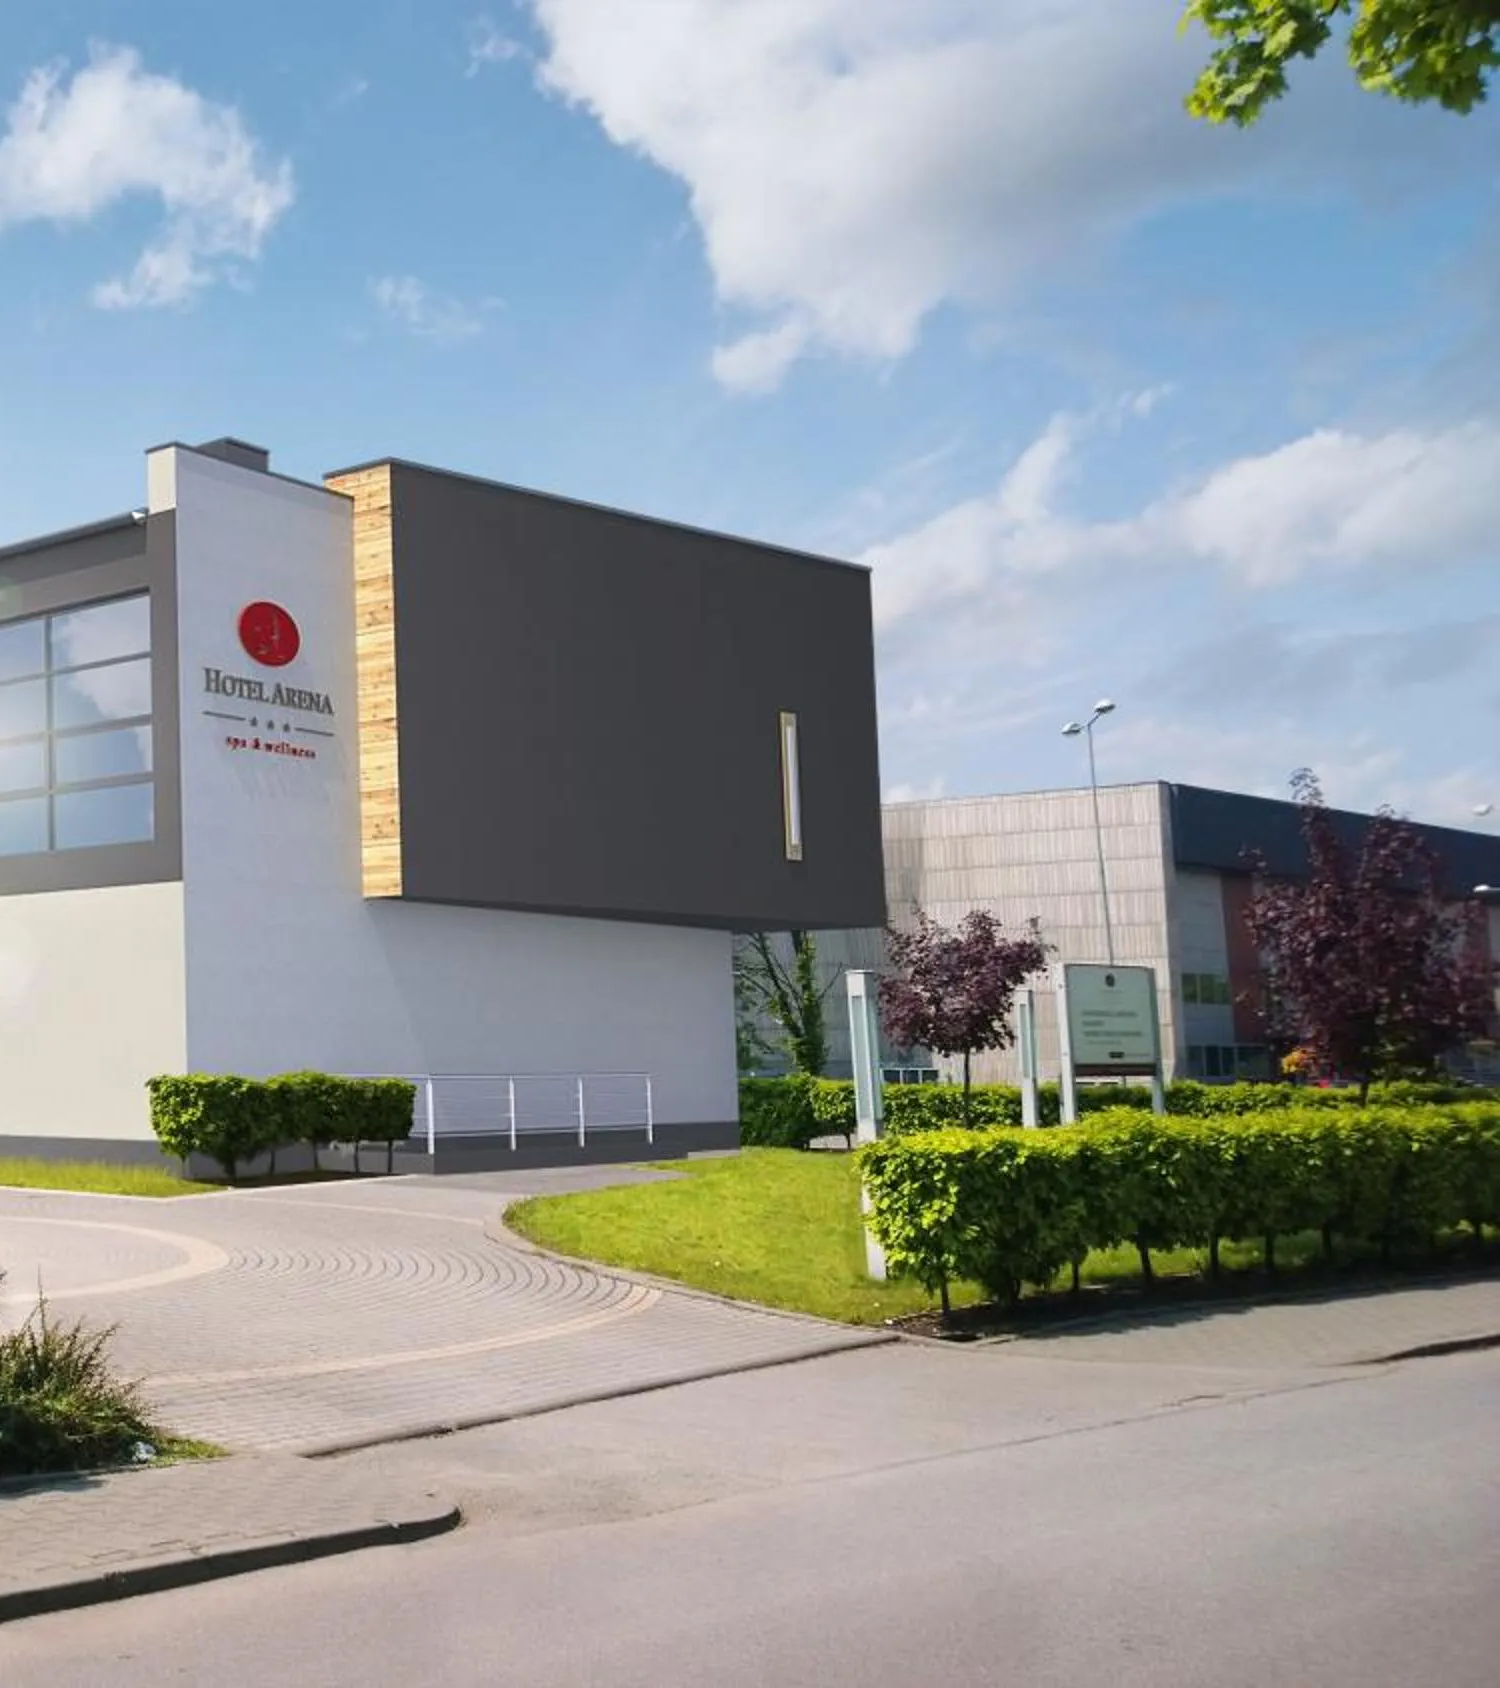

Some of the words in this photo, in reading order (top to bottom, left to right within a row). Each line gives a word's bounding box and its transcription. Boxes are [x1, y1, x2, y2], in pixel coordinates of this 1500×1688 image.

[202, 667, 269, 703] HOTEL
[271, 682, 335, 717] ARENA
[226, 736, 247, 750] spa
[251, 737, 261, 750] &
[264, 740, 317, 759] wellness
